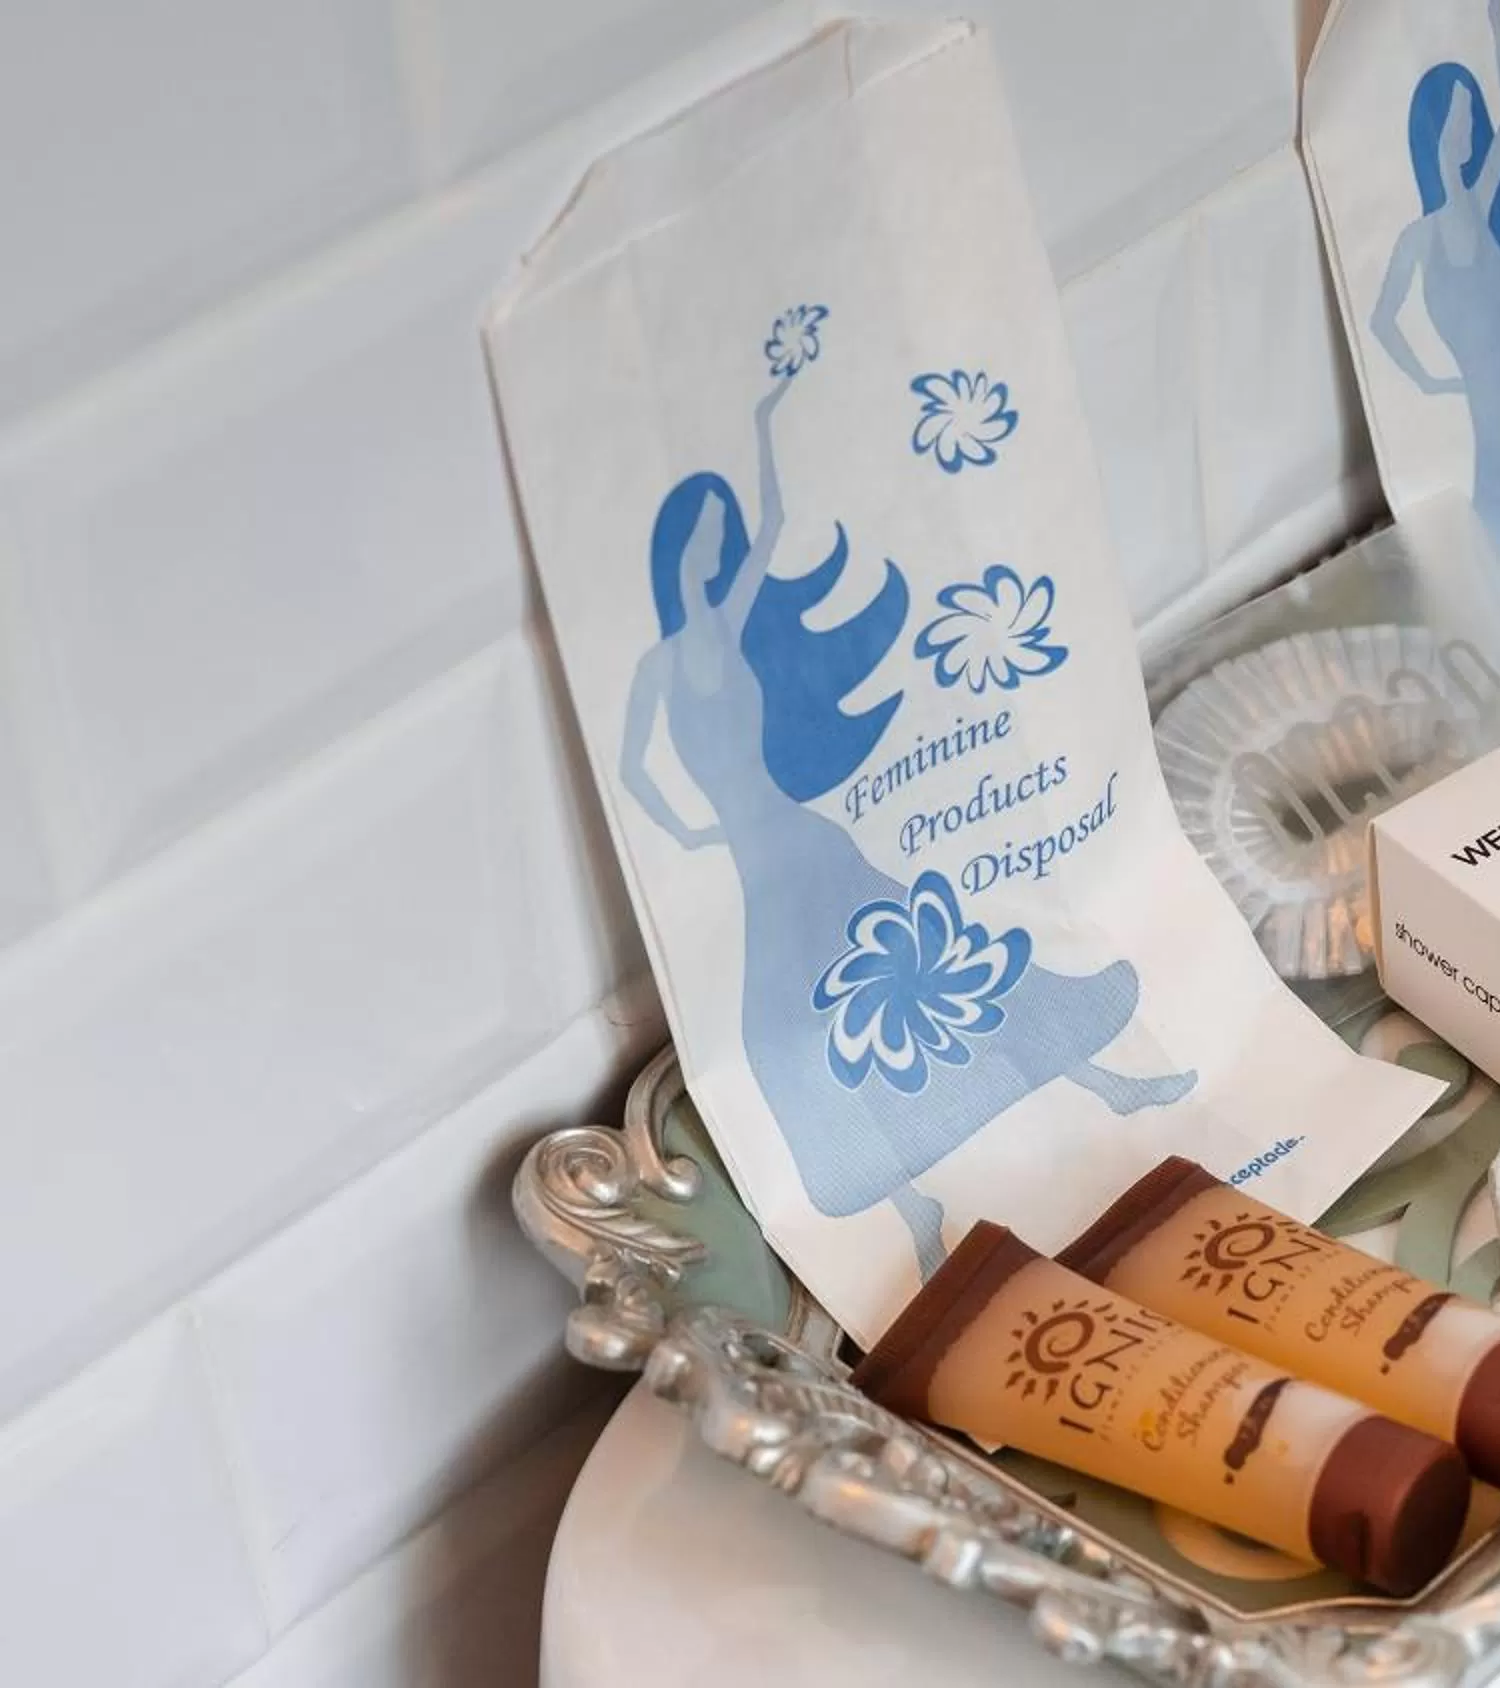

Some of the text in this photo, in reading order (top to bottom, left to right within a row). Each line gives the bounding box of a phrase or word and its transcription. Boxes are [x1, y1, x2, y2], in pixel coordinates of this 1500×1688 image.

[845, 710, 1013, 824] Feminine
[899, 755, 1068, 858] Products
[960, 771, 1119, 896] Disposal
[1395, 922, 1459, 982] shower
[1226, 1229, 1343, 1325] IGNI
